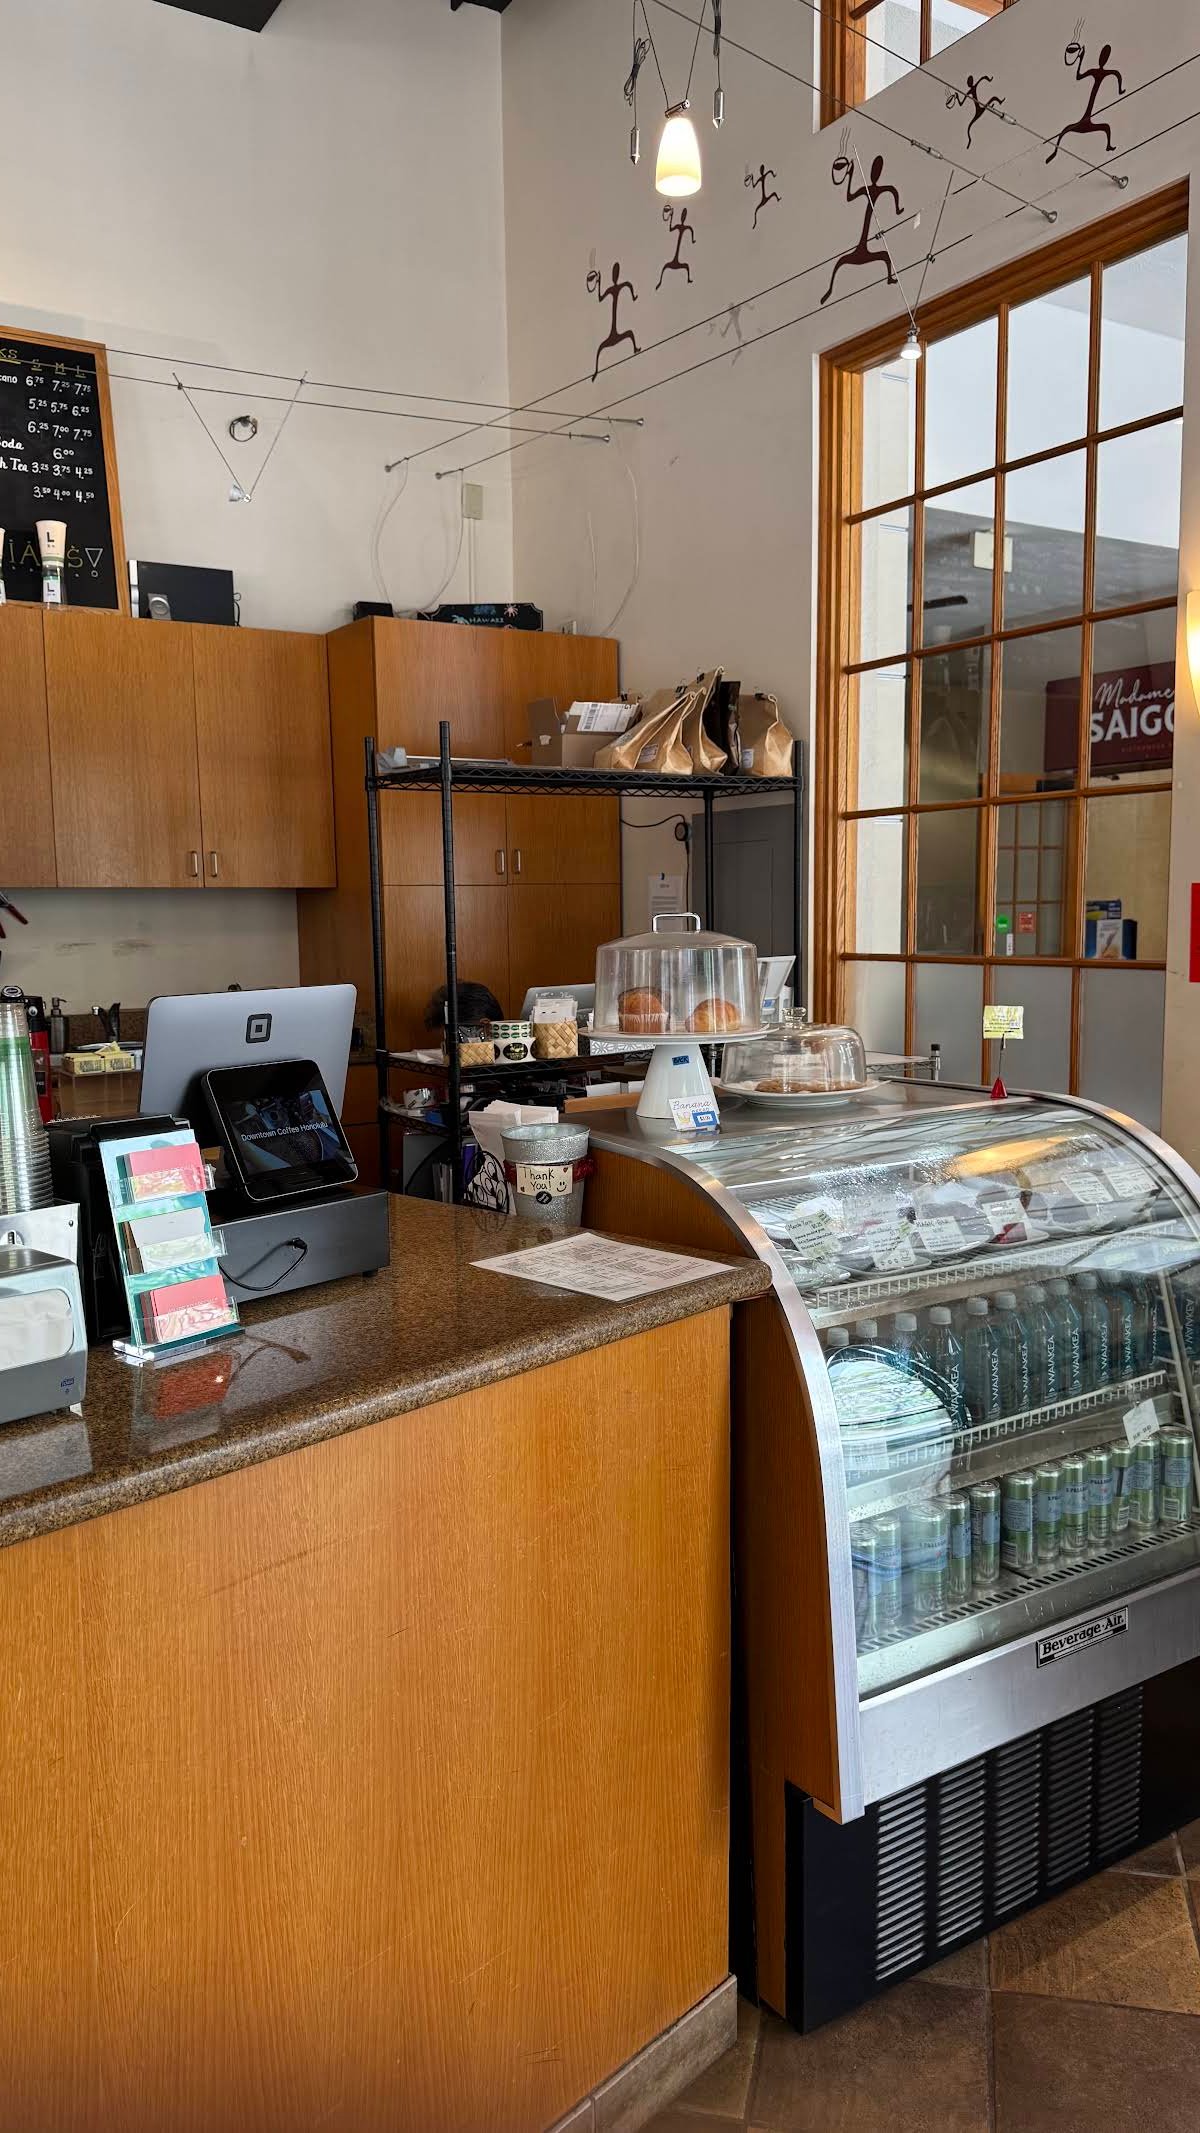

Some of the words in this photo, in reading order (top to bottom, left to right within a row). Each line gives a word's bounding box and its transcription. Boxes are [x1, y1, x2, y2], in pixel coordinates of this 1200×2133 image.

[26, 375, 44, 387] 6.75
[52, 380, 70, 392] 7.25
[74, 383, 91, 396] 7.75
[28, 398, 47, 410] 5.25
[50, 402, 69, 413] 5.75
[72, 405, 90, 417] 6.25
[27, 421, 49, 434] 6.25
[52, 425, 70, 438] 7.00
[73, 429, 92, 441] 7.75
[0, 438, 25, 451] oda
[53, 448, 75, 460] 6.00
[10, 457, 29, 472] Tea
[31, 461, 49, 474] 3.25
[52, 464, 71, 477] 3.75
[75, 466, 93, 480] 4.25
[33, 486, 51, 498] 3.50
[53, 489, 71, 501] 4.00
[75, 490, 95, 503] 4.50
[1095, 678, 1175, 710] Madame
[240, 1129, 277, 1141] Downtown
[277, 1125, 300, 1136] Coffee
[300, 1121, 328, 1132] Honolulu
[519, 1166, 555, 1180] Thank
[530, 1180, 552, 1192] You!
